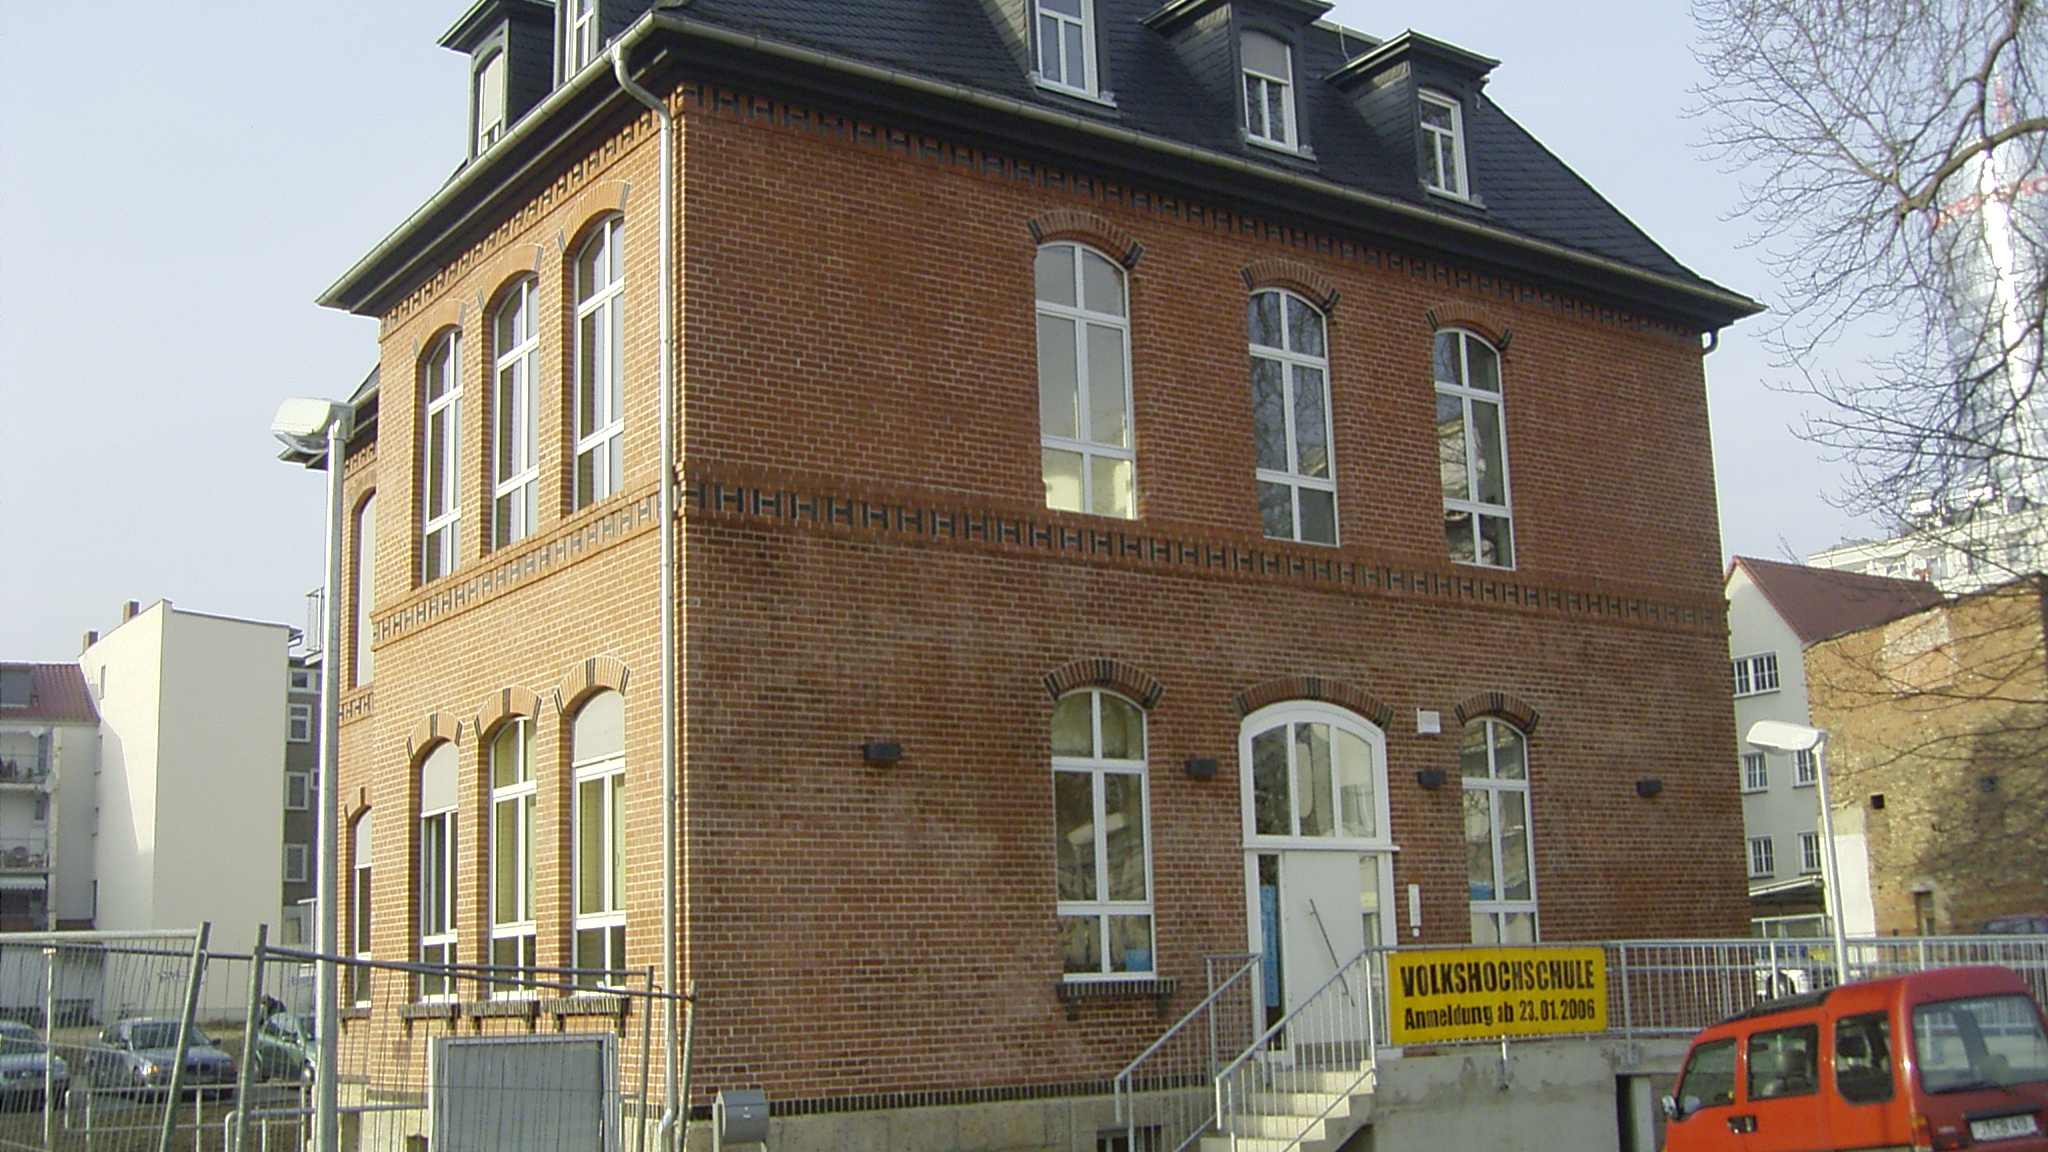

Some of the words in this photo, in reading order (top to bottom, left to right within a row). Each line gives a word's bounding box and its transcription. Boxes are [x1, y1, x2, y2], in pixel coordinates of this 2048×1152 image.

[1400, 960, 1595, 997] VOLKSHOCHSCHULE
[1404, 1003, 1493, 1030] Anmeldung
[1497, 1001, 1514, 1023] ab
[1519, 998, 1595, 1022] 23.01.2006
